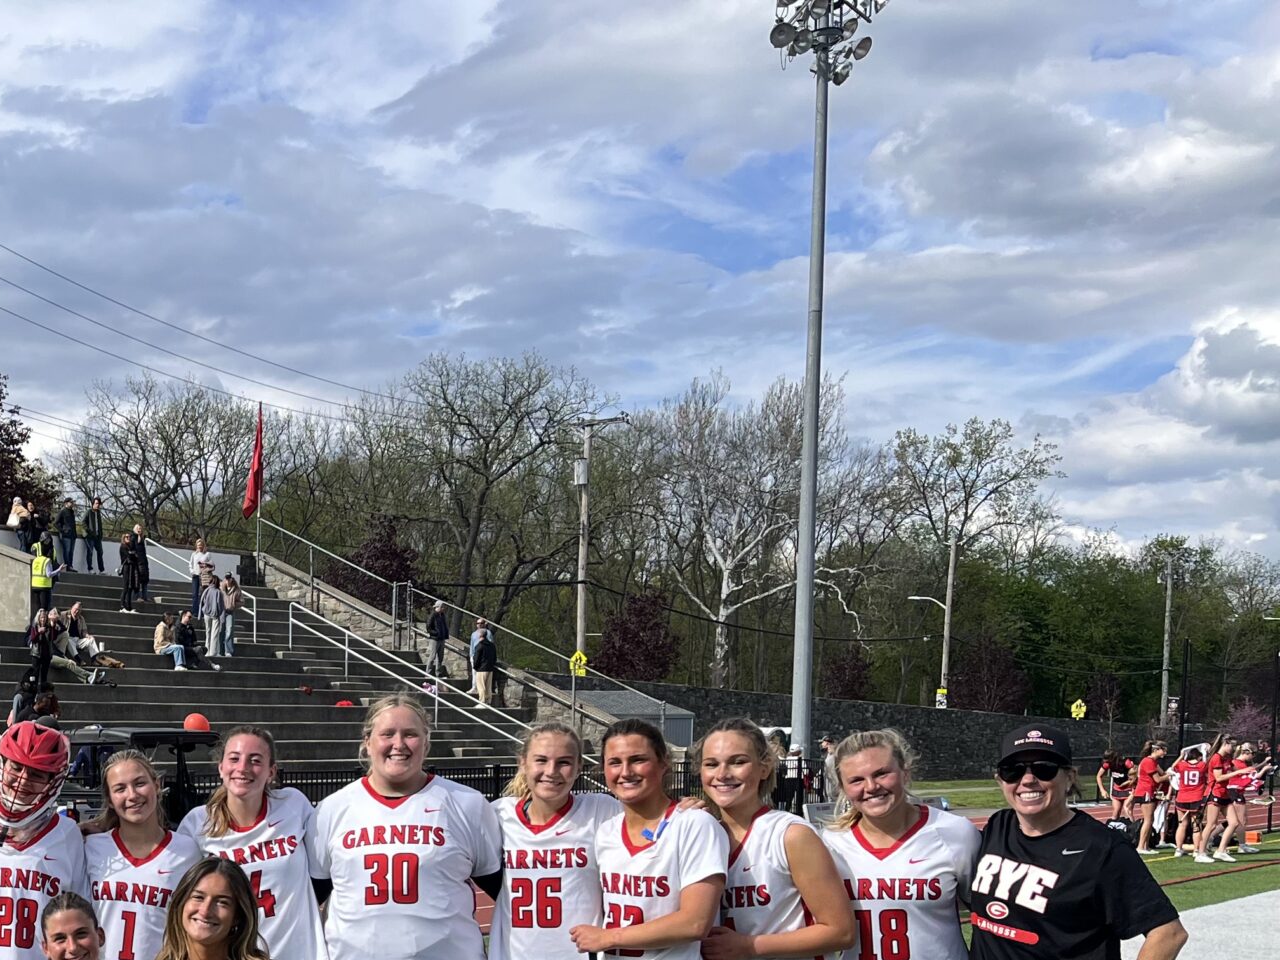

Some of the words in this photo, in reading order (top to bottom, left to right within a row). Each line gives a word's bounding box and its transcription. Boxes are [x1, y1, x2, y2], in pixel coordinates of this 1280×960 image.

[1184, 770, 1200, 786] 19
[342, 824, 446, 850] GARNETS
[503, 847, 588, 870] ARNETS
[363, 852, 420, 906] 30
[971, 853, 1060, 914] RYE
[511, 877, 562, 929] 26
